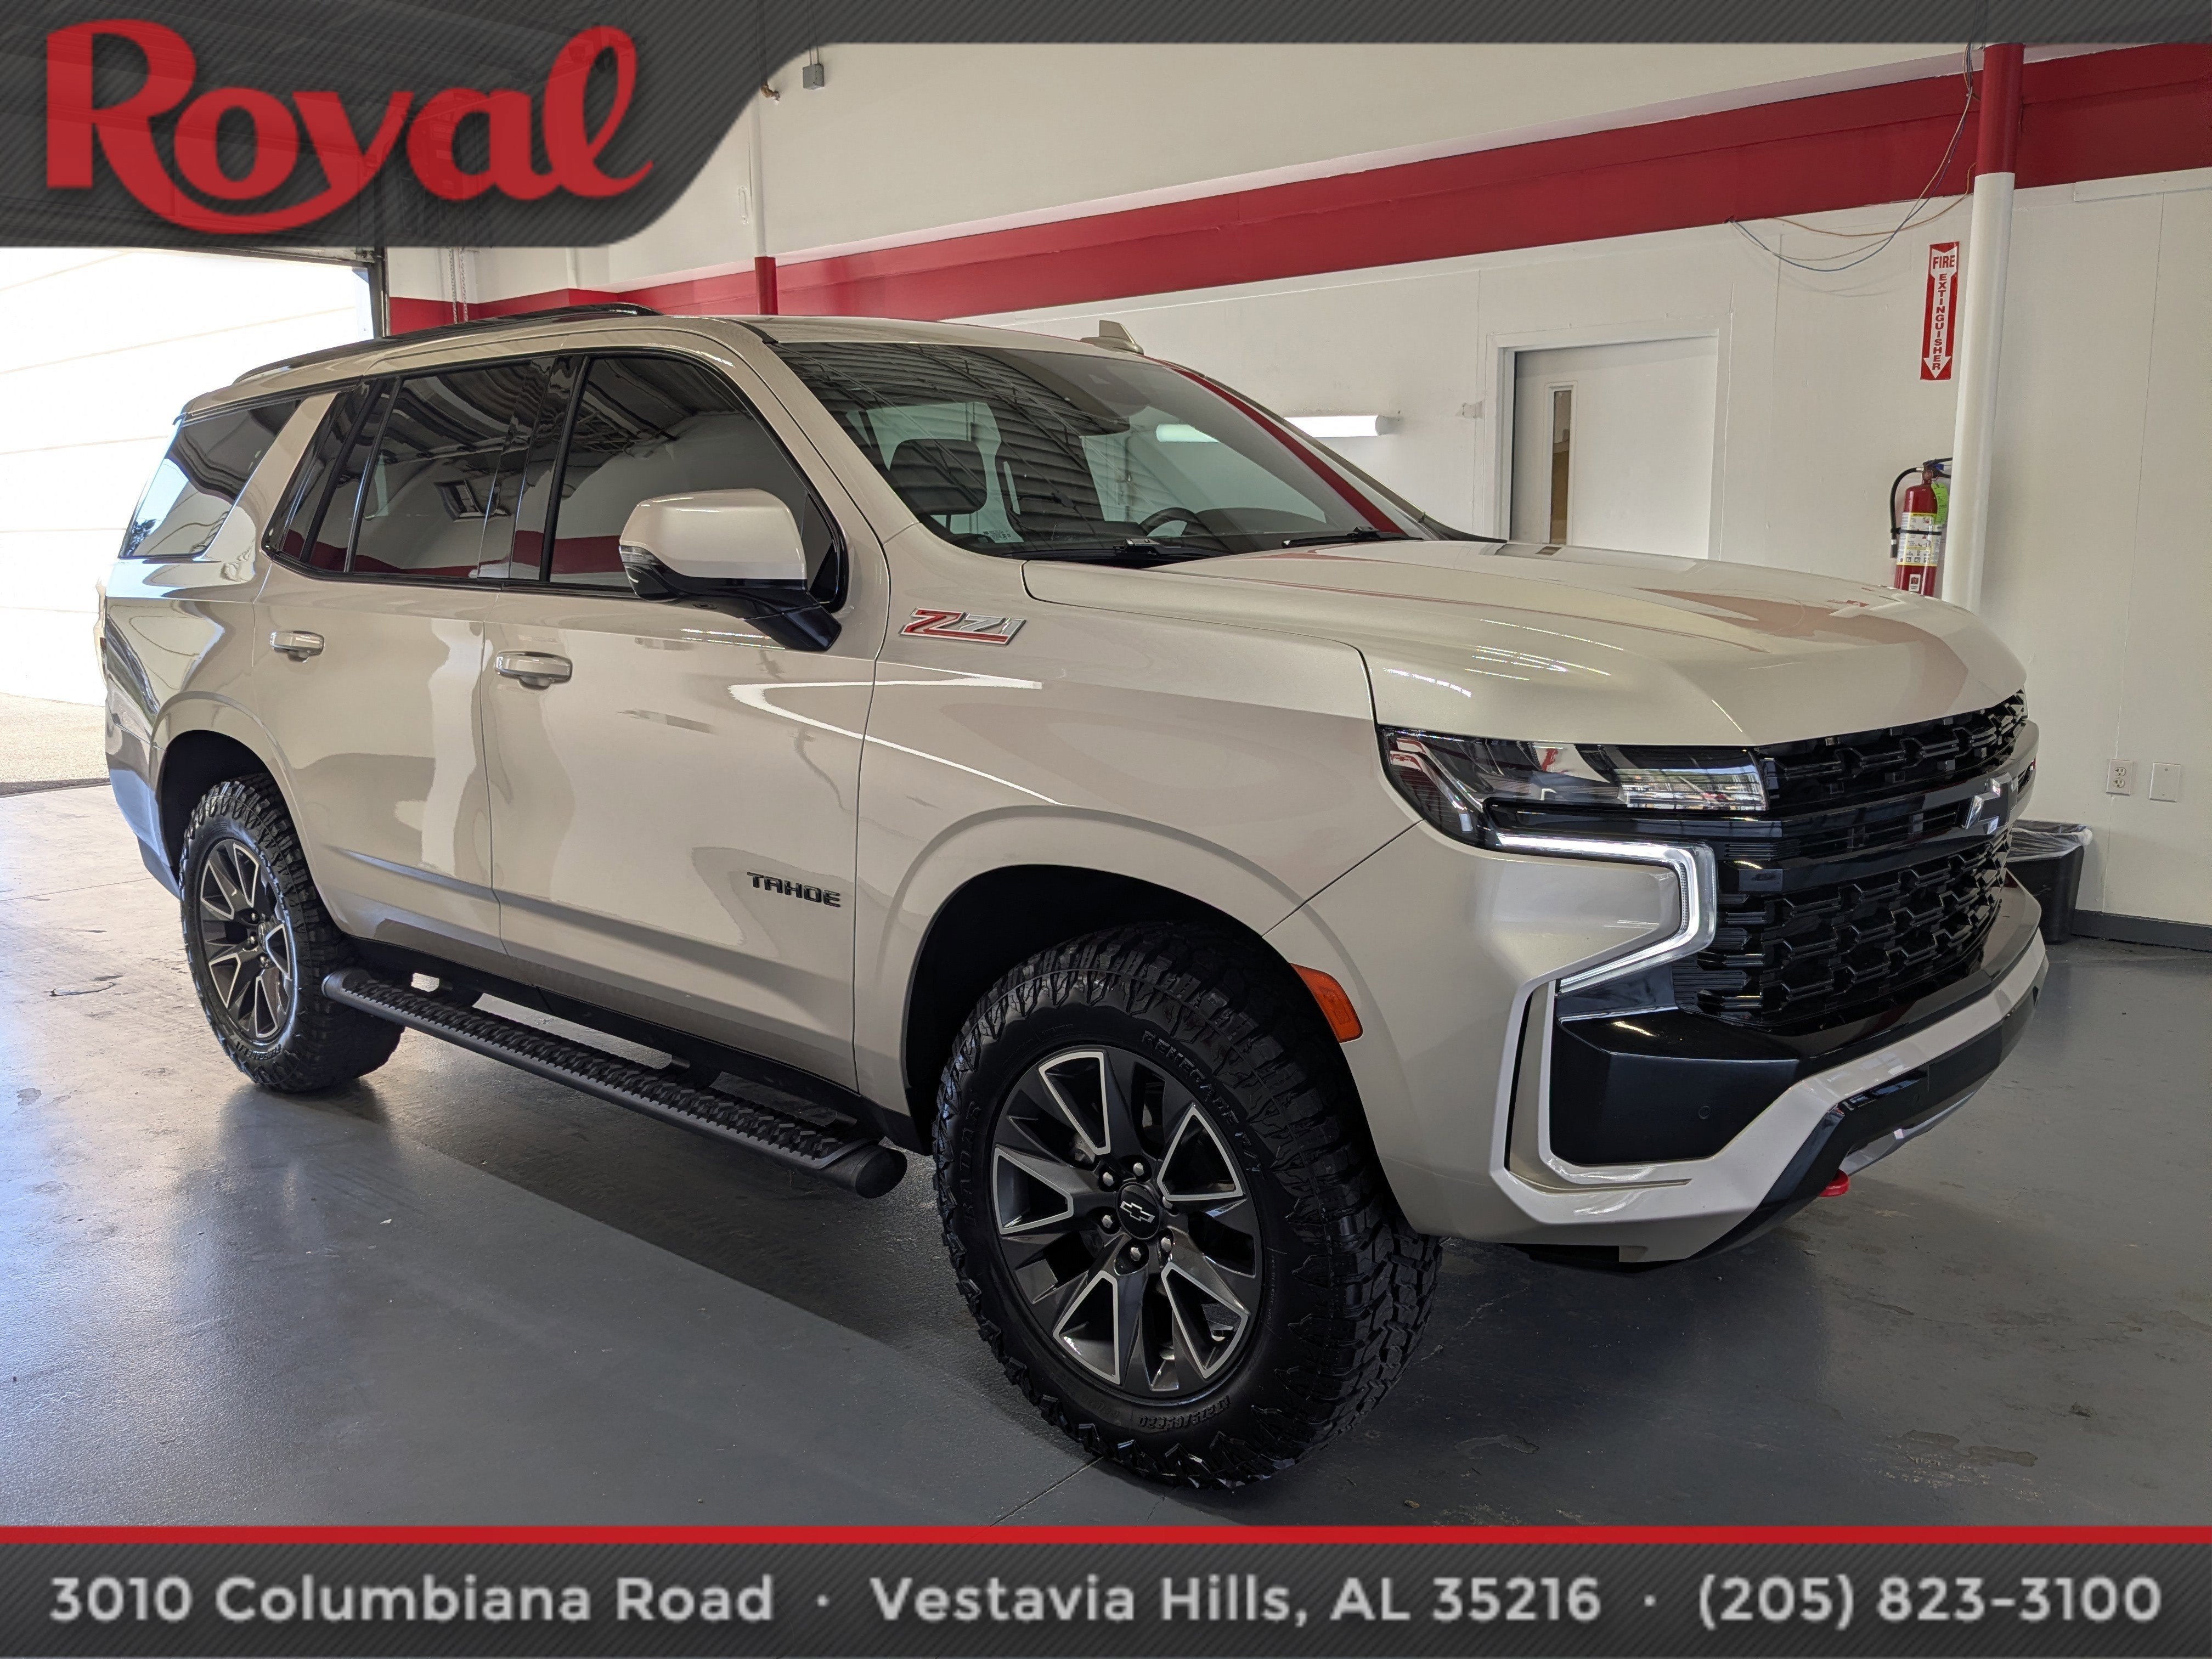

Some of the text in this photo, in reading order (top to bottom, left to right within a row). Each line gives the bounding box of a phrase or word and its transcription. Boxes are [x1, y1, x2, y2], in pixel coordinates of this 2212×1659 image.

[1932, 255, 1955, 269] FIRE
[1932, 273, 1948, 370] EXTINGUISHER
[899, 607, 1026, 646] Z71
[747, 871, 841, 908] TAHOE
